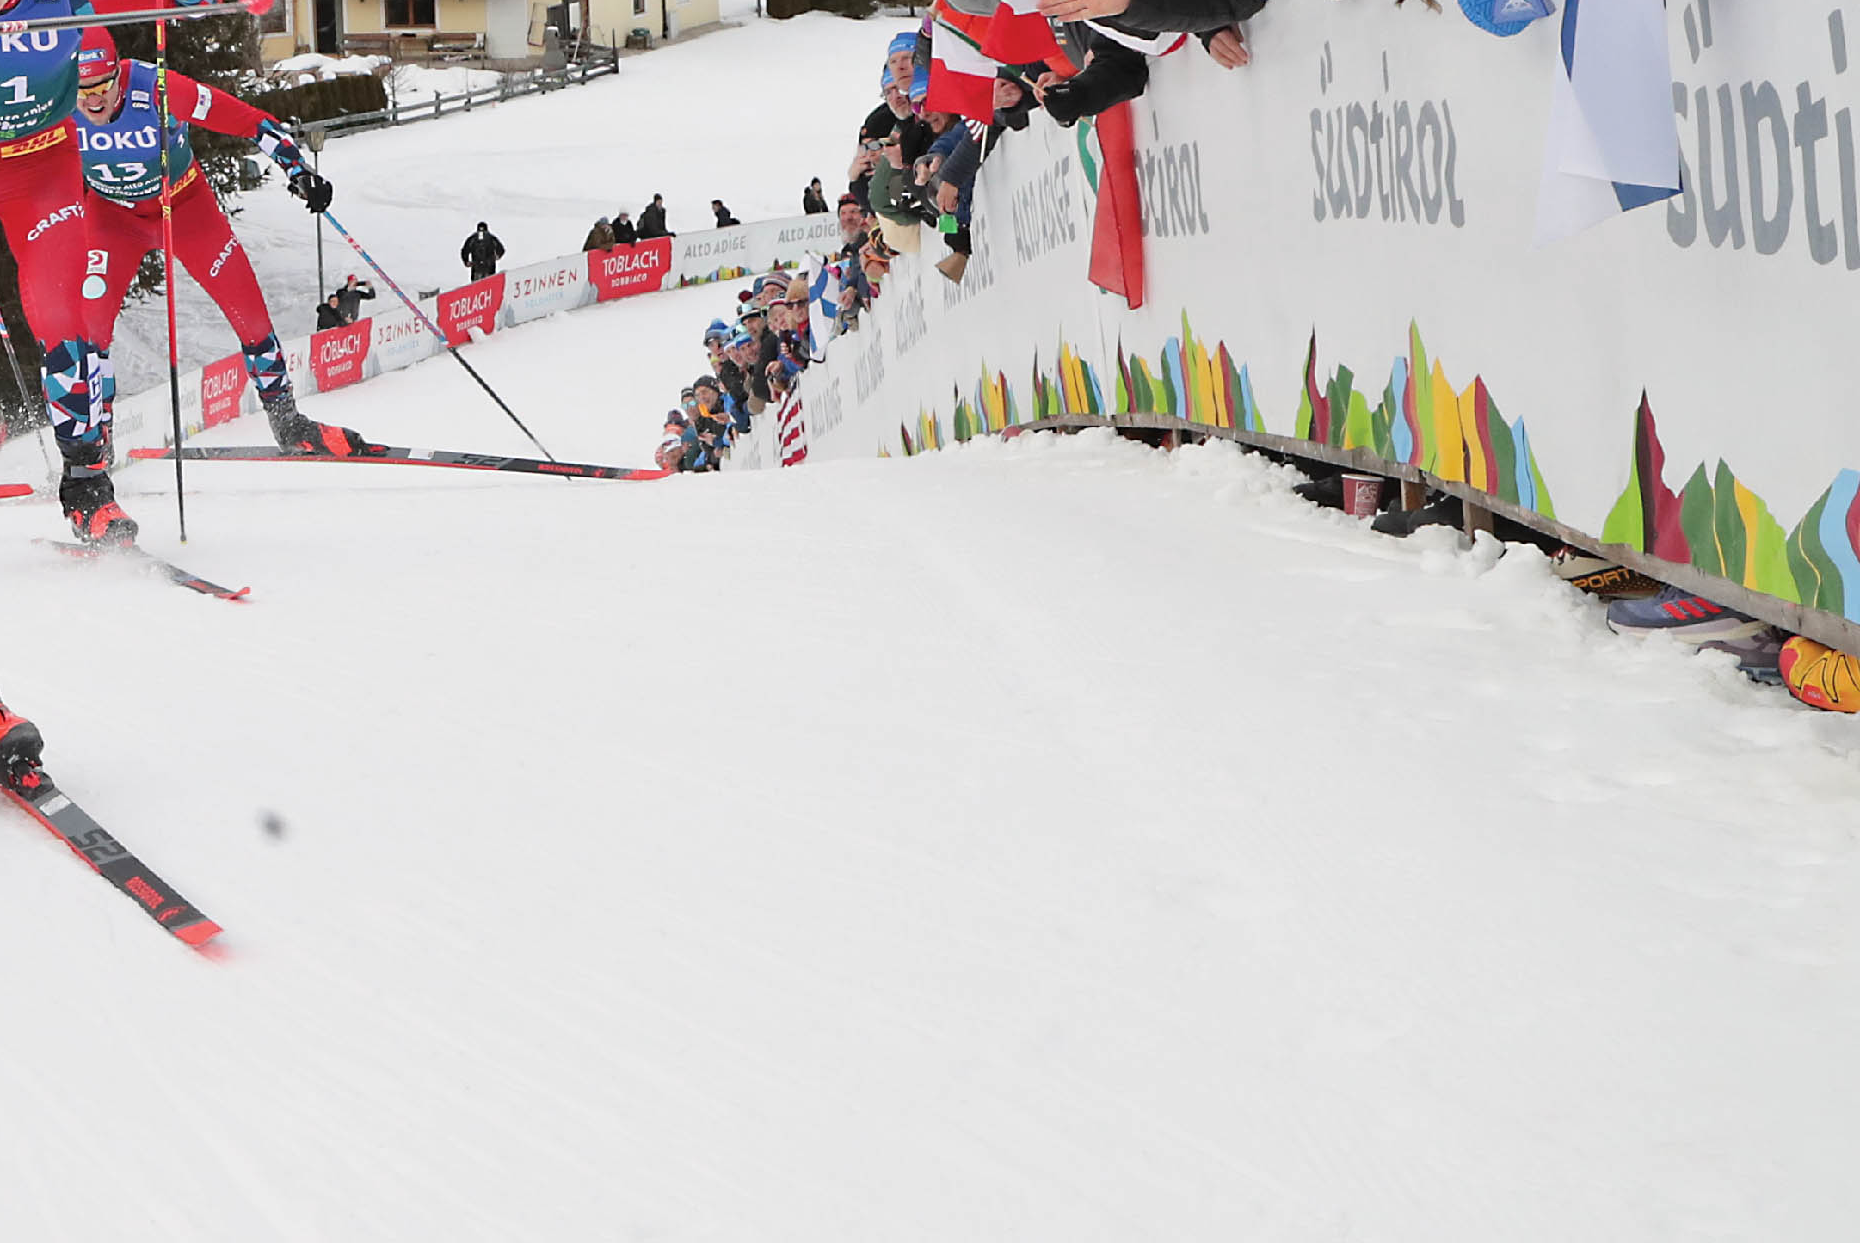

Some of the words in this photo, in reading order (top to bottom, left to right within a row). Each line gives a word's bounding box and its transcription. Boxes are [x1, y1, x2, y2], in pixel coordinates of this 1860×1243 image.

[78, 125, 158, 151] OKU
[91, 162, 148, 182] 13
[27, 204, 72, 241] CRAFT
[602, 249, 660, 277] TOBLACH
[513, 282, 522, 299] 3
[524, 267, 578, 297] ZINNEN
[449, 289, 492, 320] TOBLACH
[320, 333, 361, 365] TOBLACH
[203, 368, 239, 400] TOBLACH
